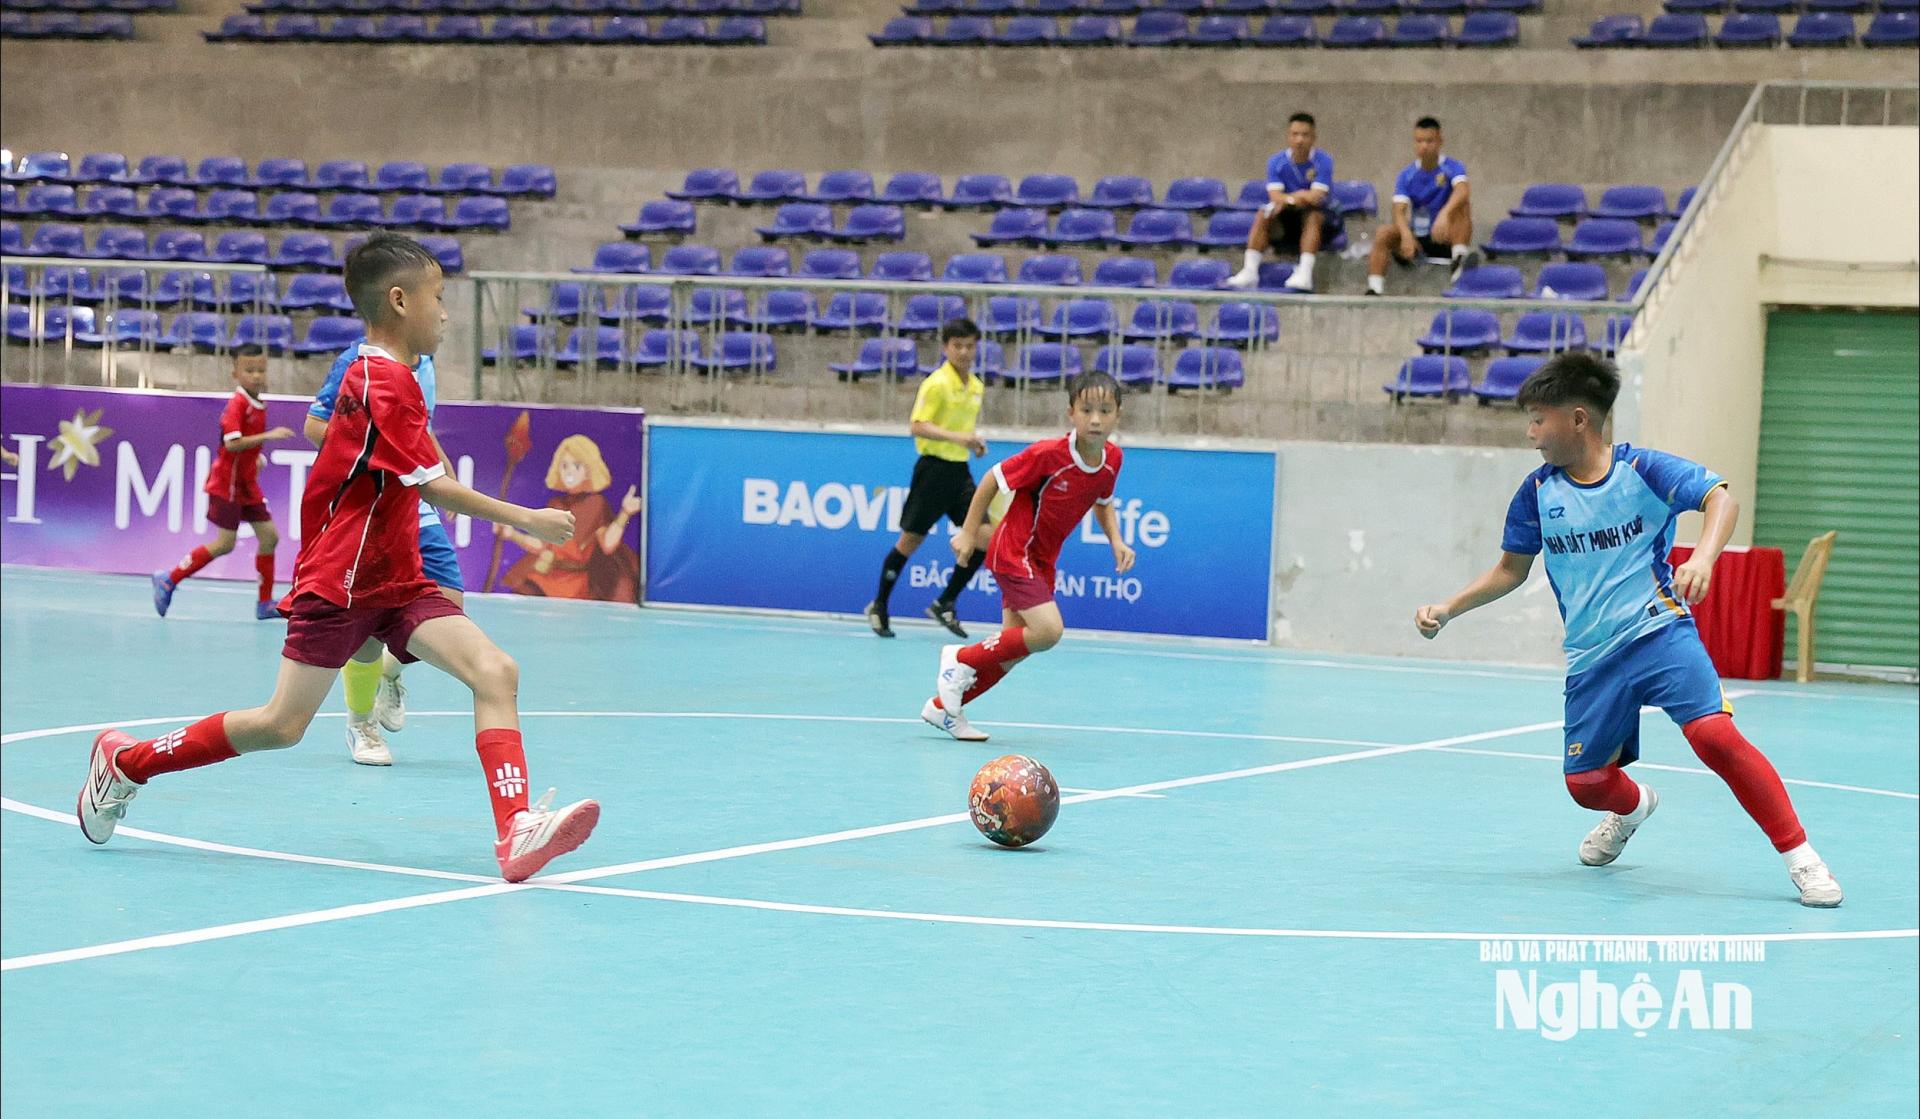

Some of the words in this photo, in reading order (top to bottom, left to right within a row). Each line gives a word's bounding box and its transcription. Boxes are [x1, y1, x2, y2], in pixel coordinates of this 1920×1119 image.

[743, 478, 961, 536] BAOVI
[1588, 527, 1622, 552] MINH
[1089, 576, 1143, 604] THỌ
